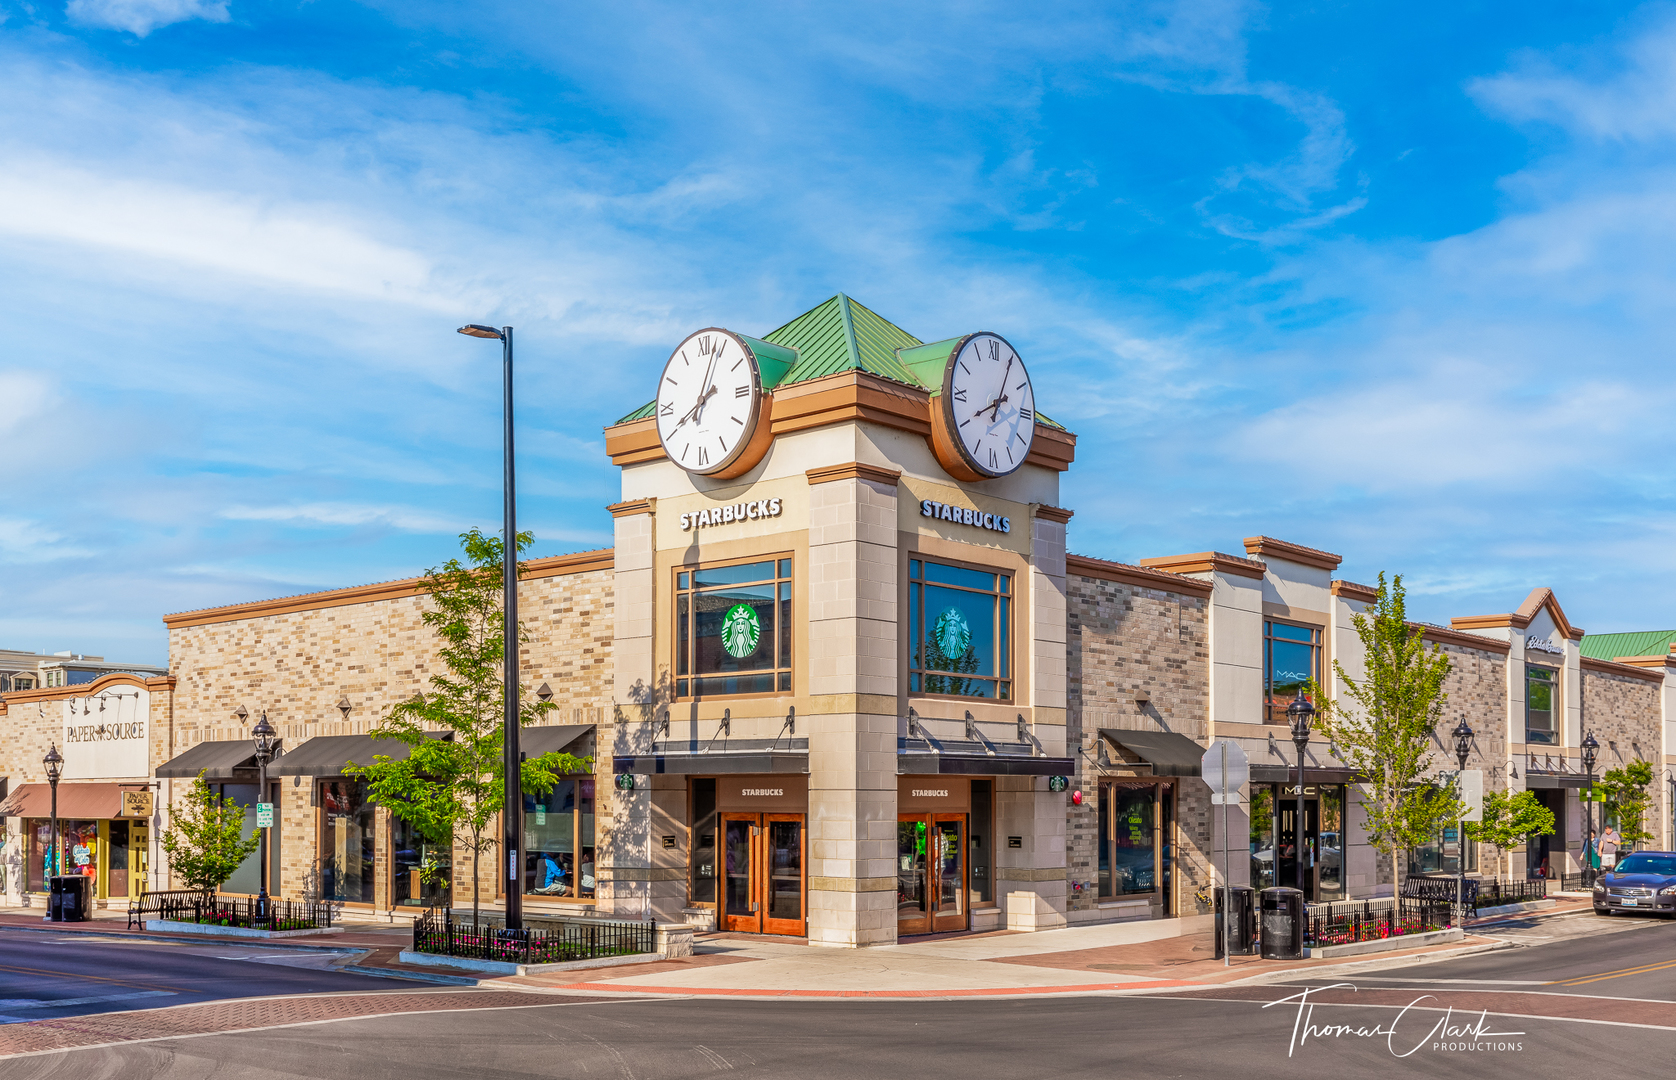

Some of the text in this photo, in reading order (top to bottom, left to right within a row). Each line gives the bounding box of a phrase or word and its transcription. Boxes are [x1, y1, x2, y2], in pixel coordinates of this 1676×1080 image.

[698, 335, 710, 357] XII
[988, 339, 999, 361] XII
[680, 498, 781, 530] STARBUCKS
[921, 499, 1011, 533] STARBUCKS
[1276, 670, 1307, 681] MAC
[67, 721, 145, 743] PAPER SOURCE
[741, 788, 784, 796] STARBUCKS
[911, 789, 949, 797] STARBUCKS
[1284, 786, 1316, 795] MC
